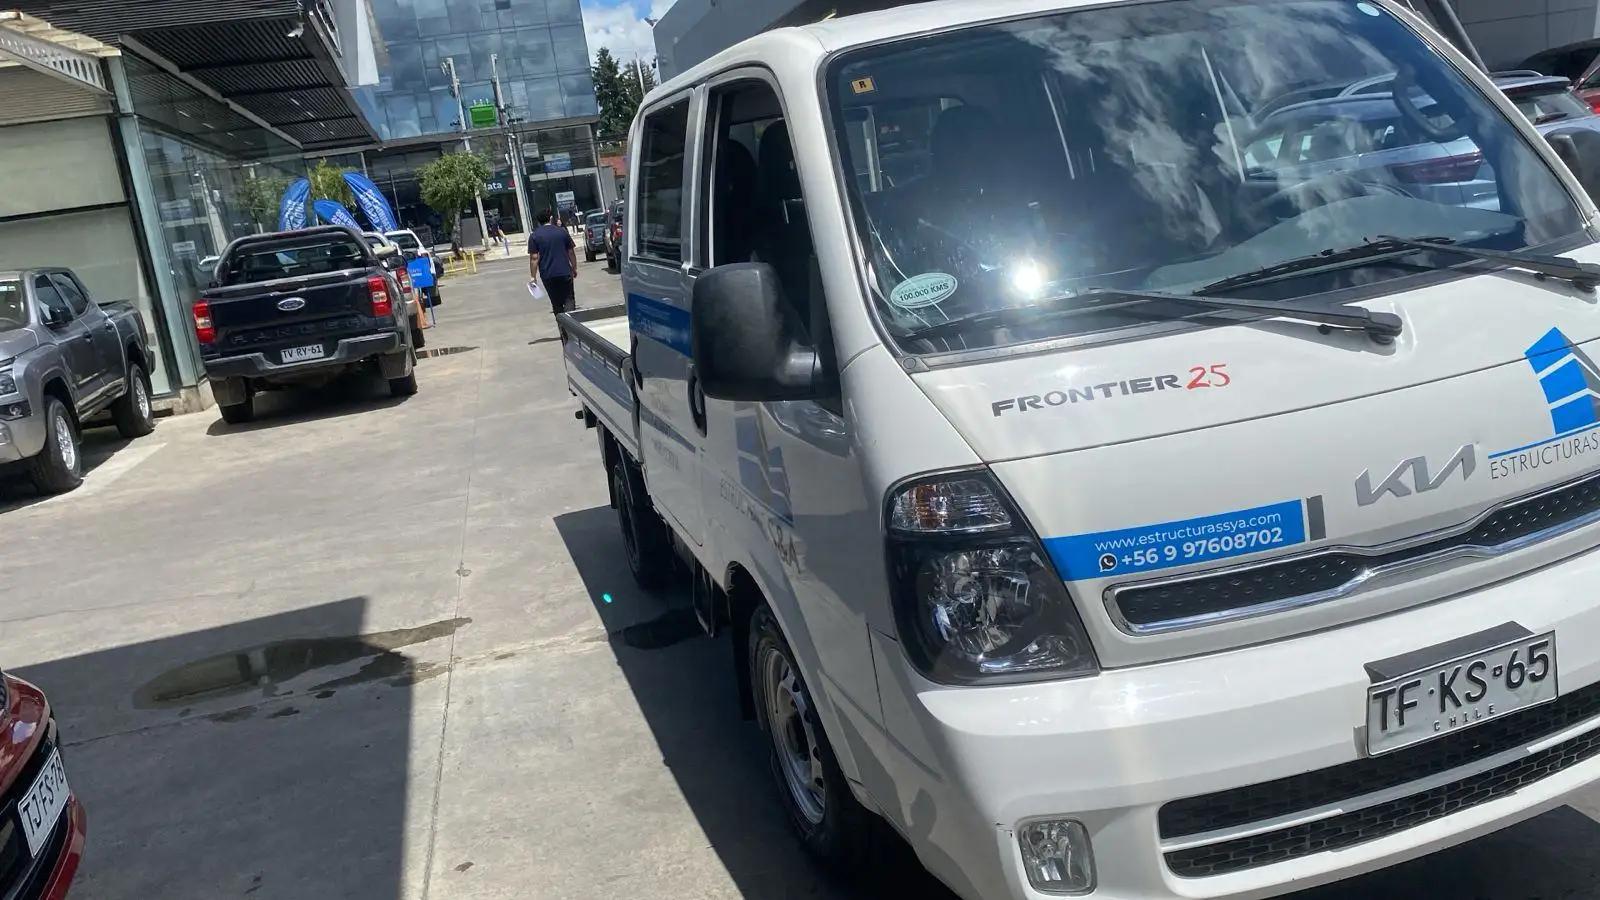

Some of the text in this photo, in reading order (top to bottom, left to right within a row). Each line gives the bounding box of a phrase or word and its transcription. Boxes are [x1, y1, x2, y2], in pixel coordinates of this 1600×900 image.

[900, 288, 929, 302] 100.000
[930, 282, 949, 294] KMS
[991, 363, 1231, 417] FRONTIER 25
[1490, 432, 1599, 480] ESTRUCTURAS
[1094, 511, 1282, 552] www.estructurassya.com
[1121, 527, 1284, 567] +56 9 97608702
[1433, 704, 1496, 732] CHILE
